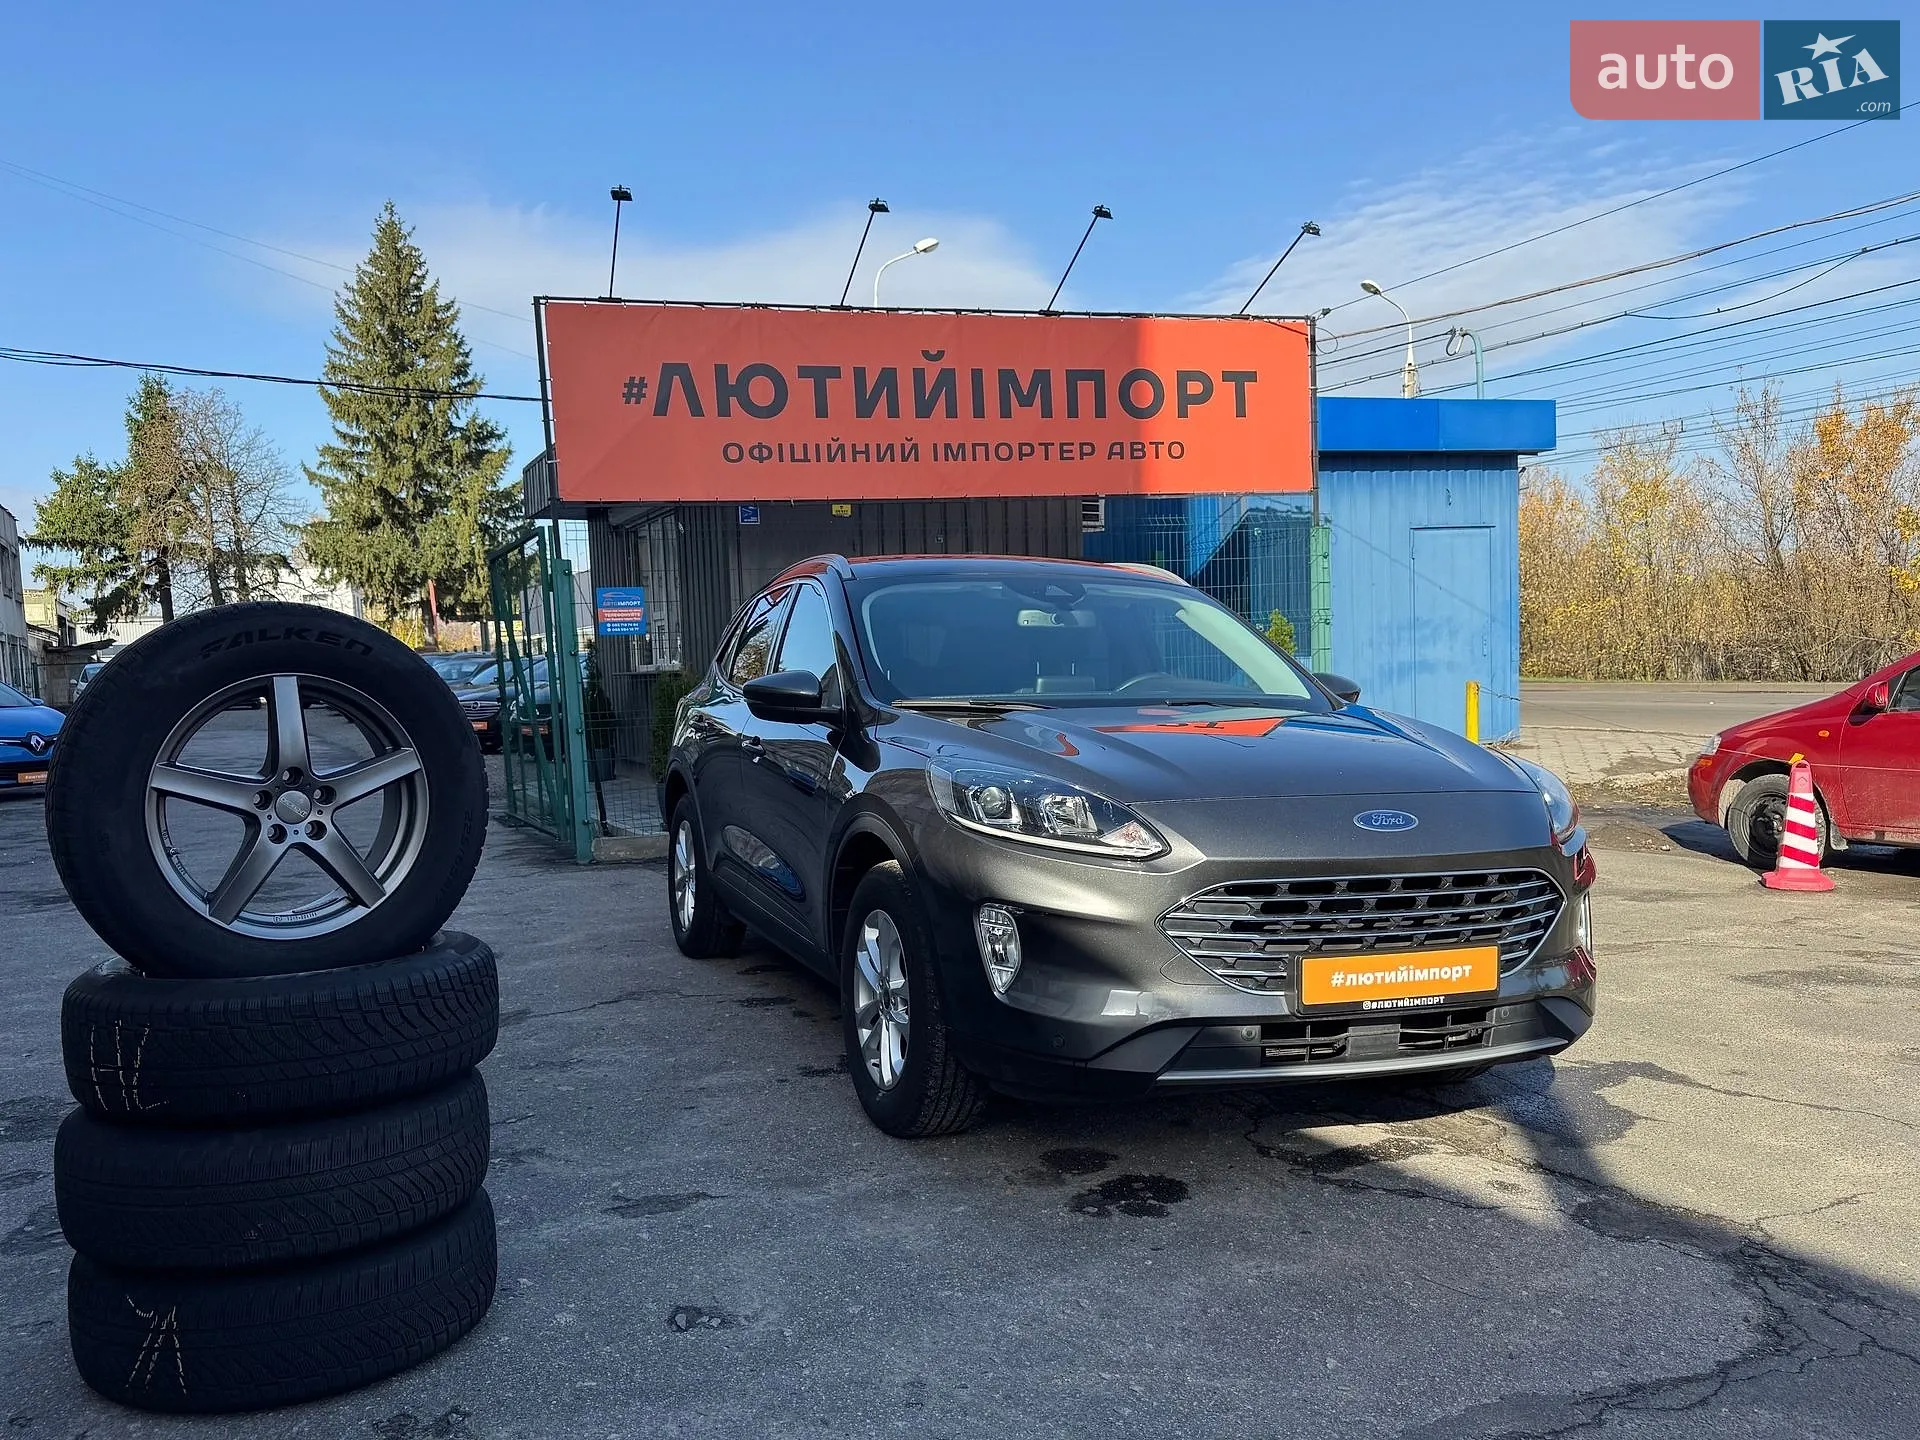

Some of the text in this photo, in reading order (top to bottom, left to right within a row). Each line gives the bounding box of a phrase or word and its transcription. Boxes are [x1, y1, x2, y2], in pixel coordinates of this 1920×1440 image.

[622, 349, 1258, 420] #ЛЮТИЙІМПОРТ
[722, 437, 1185, 464] ОФІЦІЙНИЙ ІМПОРТЕР АВТО
[200, 626, 374, 660] FALKEN
[1371, 813, 1406, 826] Ford
[1330, 964, 1473, 988] #лютийімпорт
